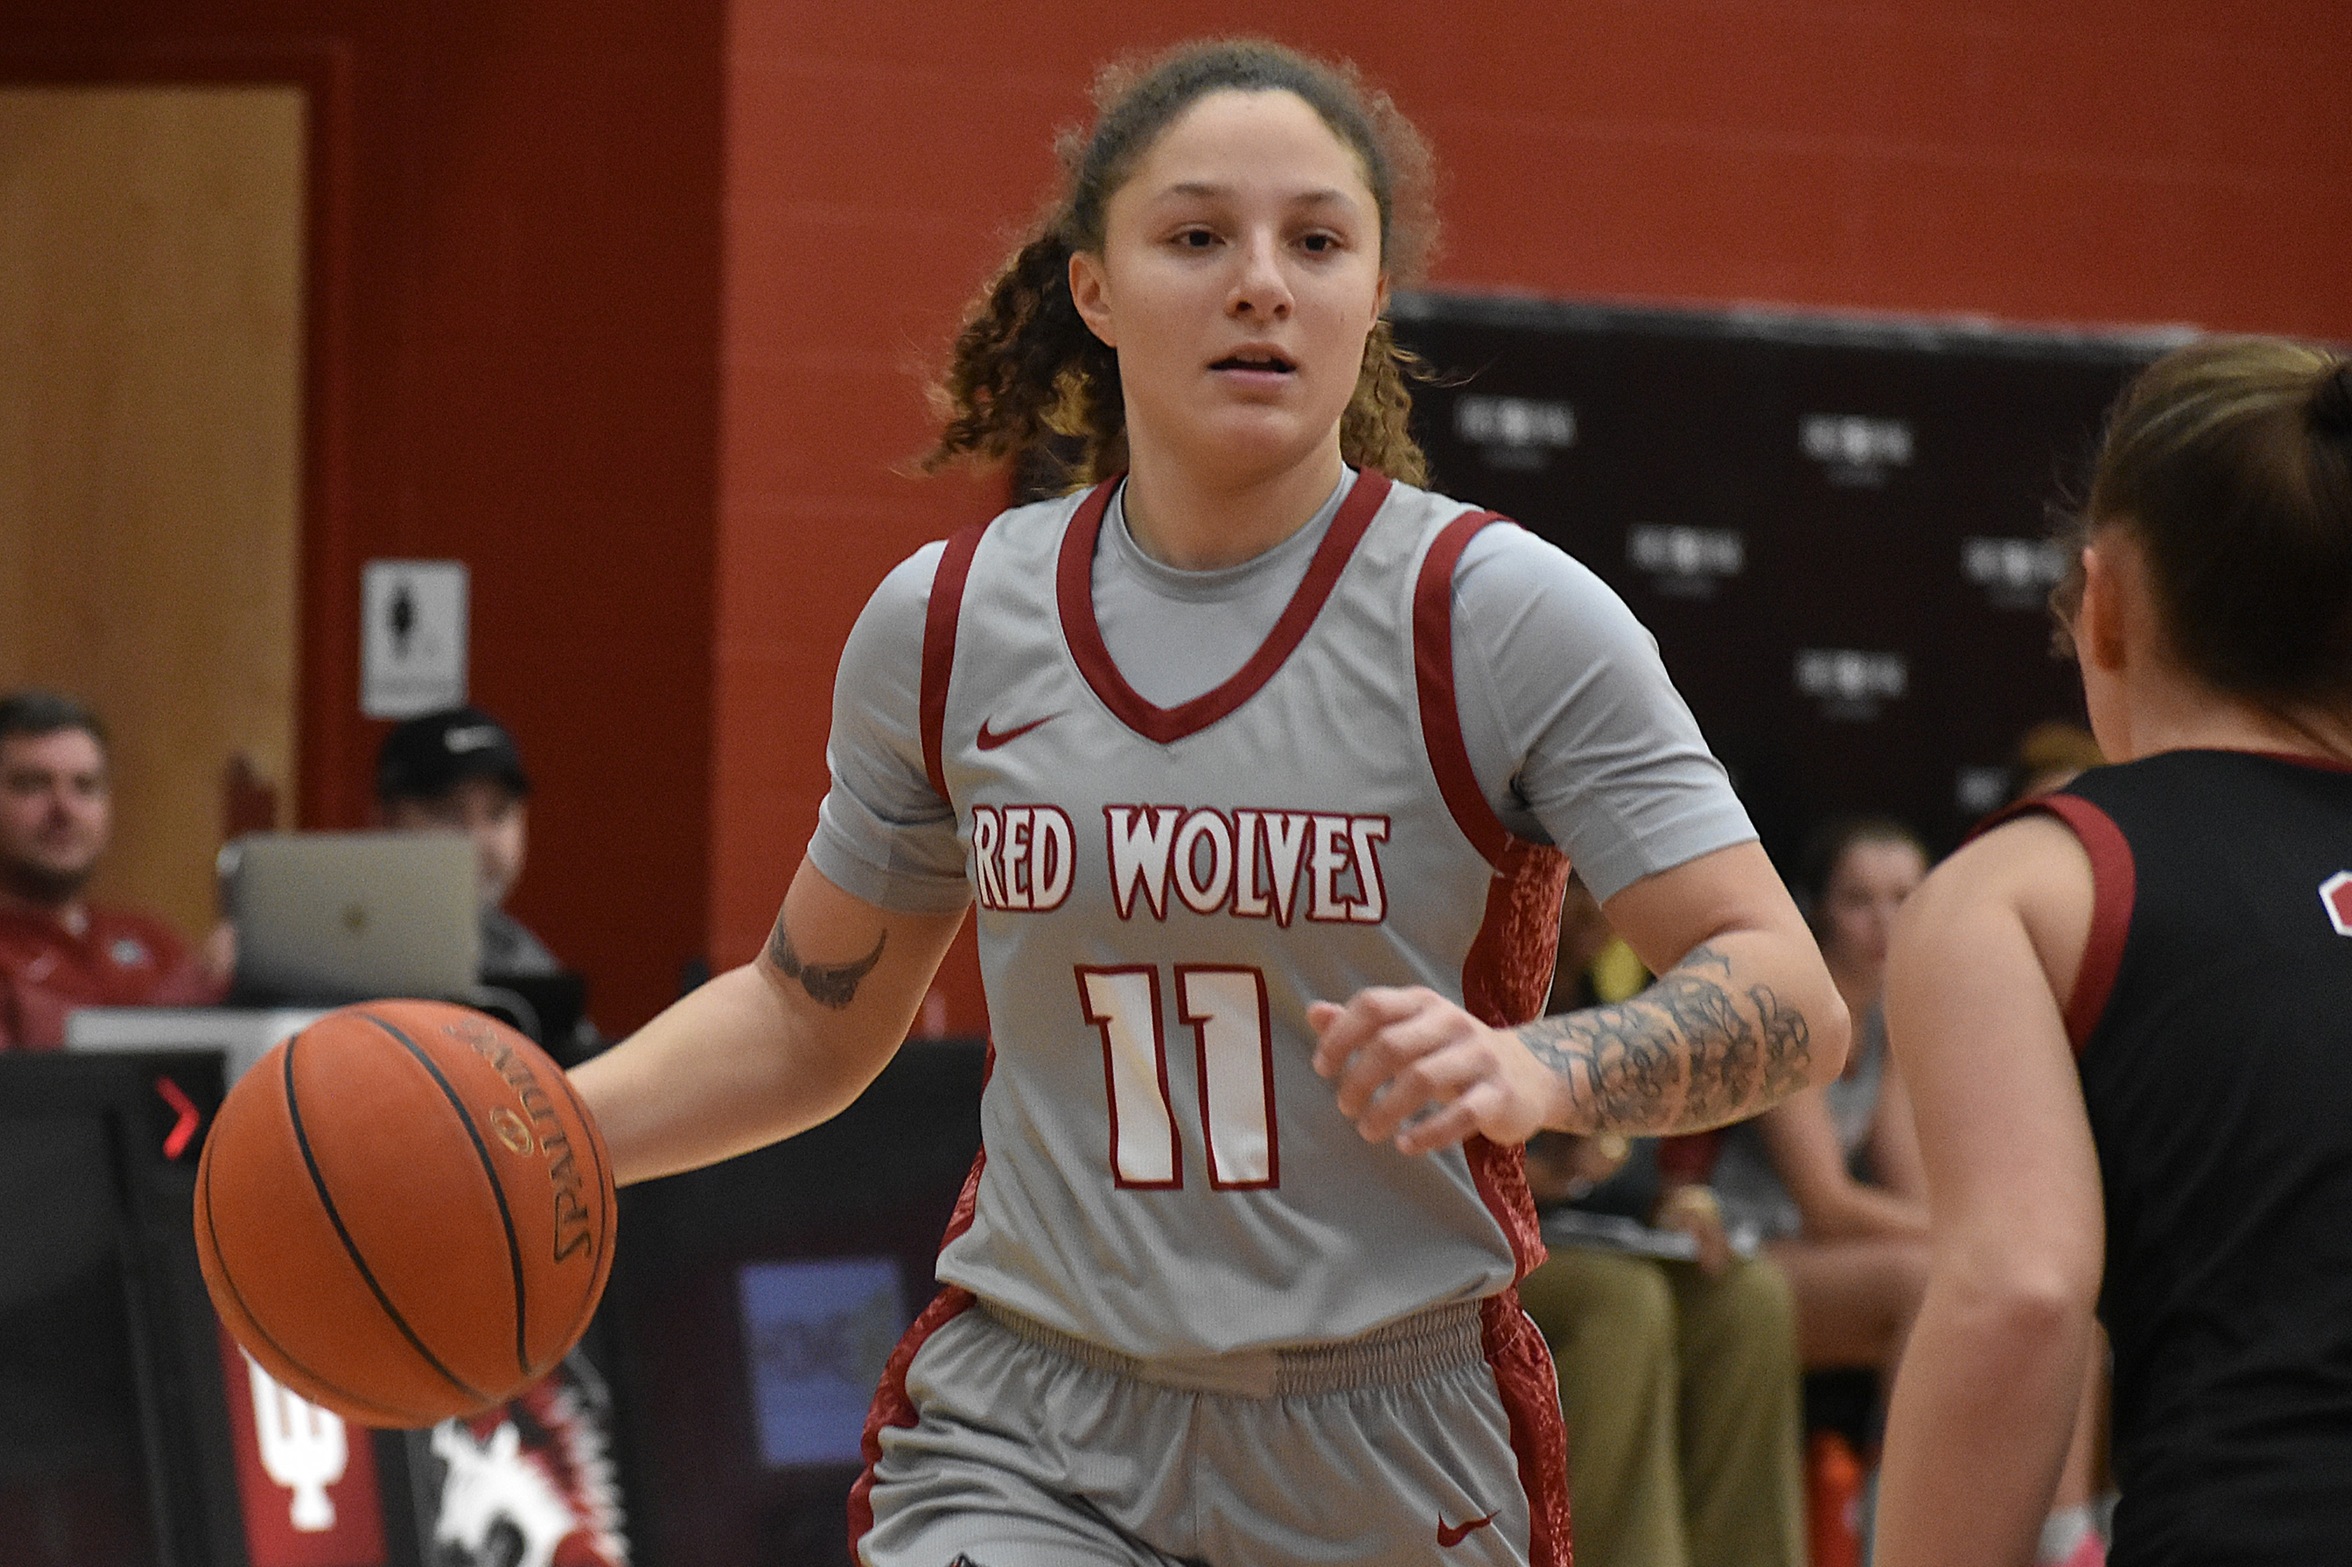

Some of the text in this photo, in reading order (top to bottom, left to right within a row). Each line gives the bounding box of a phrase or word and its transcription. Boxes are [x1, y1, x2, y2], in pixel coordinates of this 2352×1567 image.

[972, 804, 1391, 929] RED WOLVES
[1073, 962, 1280, 1191] 11
